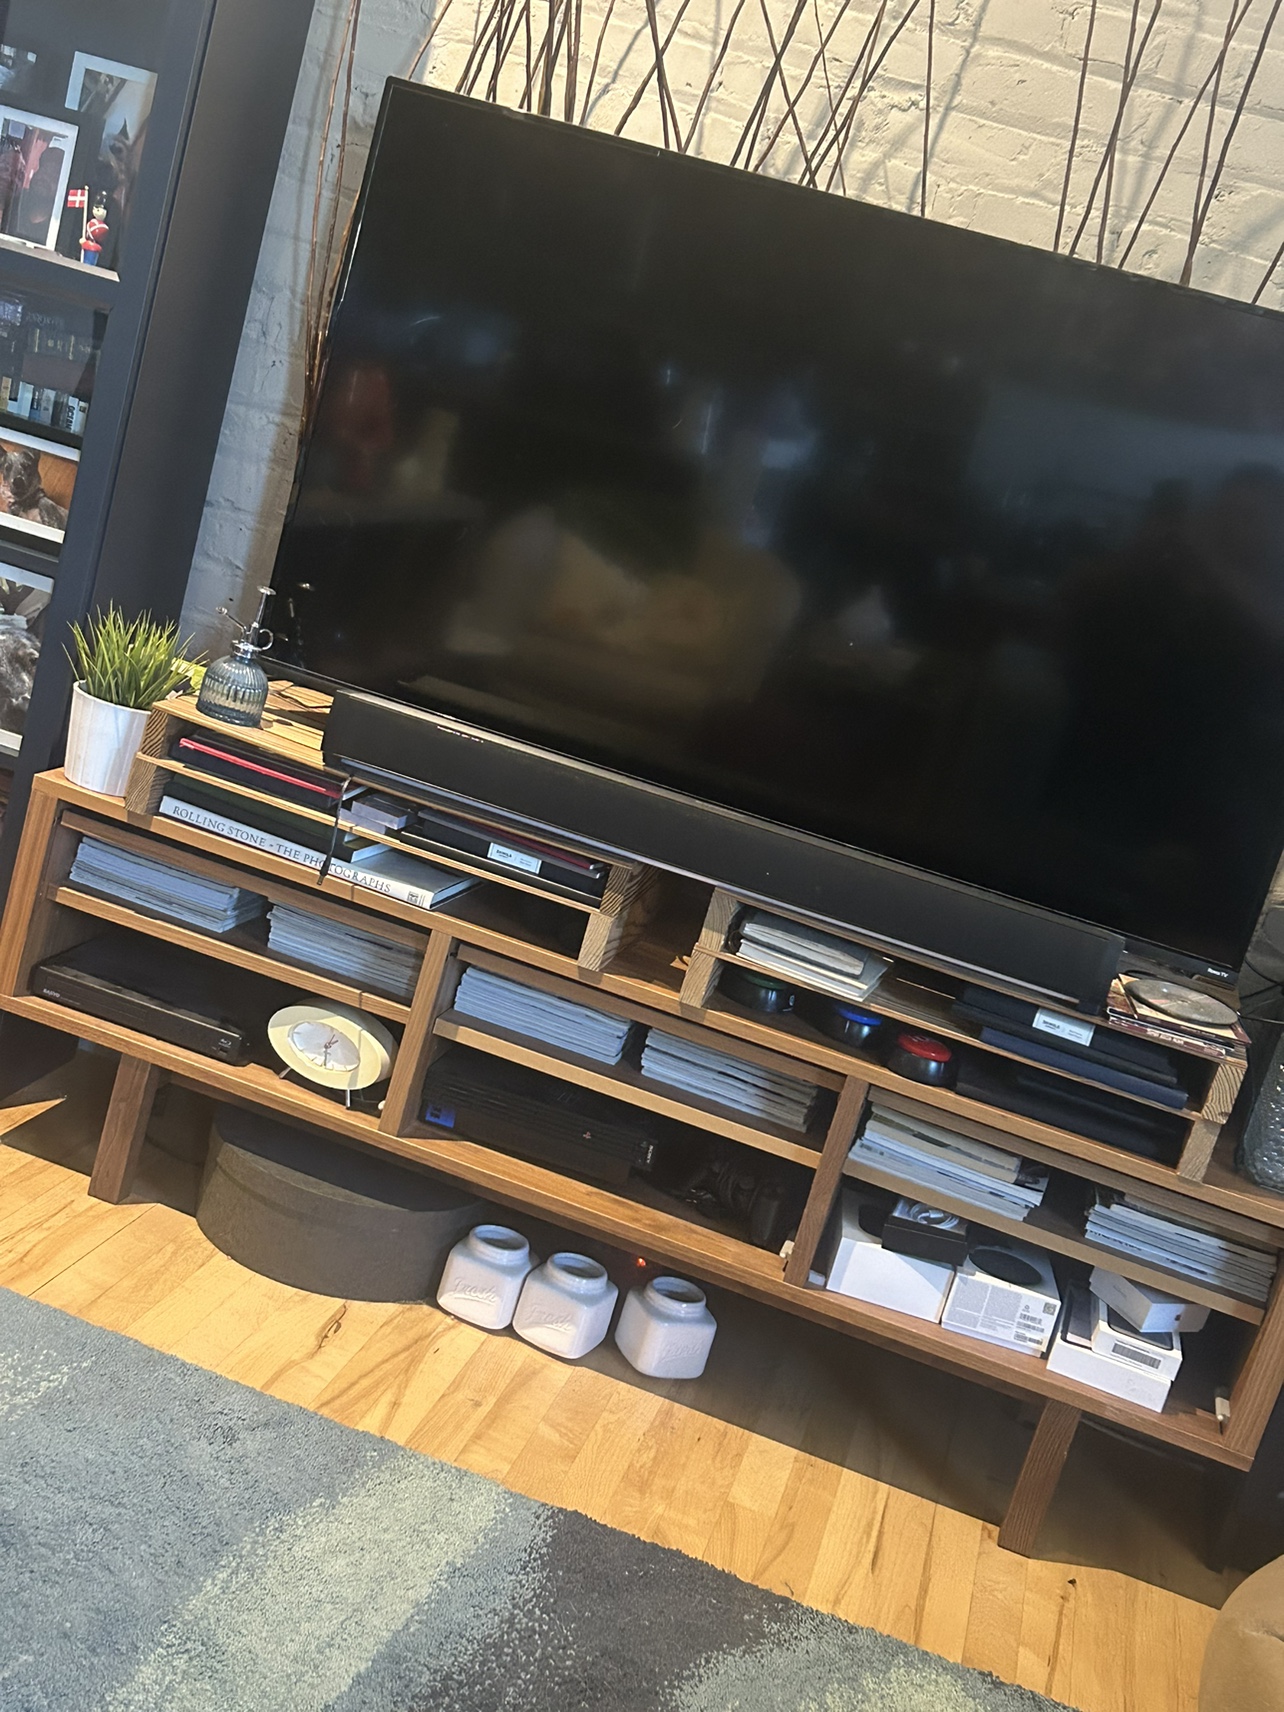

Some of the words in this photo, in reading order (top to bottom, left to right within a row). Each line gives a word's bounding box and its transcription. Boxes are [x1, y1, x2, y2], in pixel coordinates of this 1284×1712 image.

[173, 805, 226, 833] ROLLING
[227, 821, 266, 847] STONE
[276, 844, 300, 860] THE
